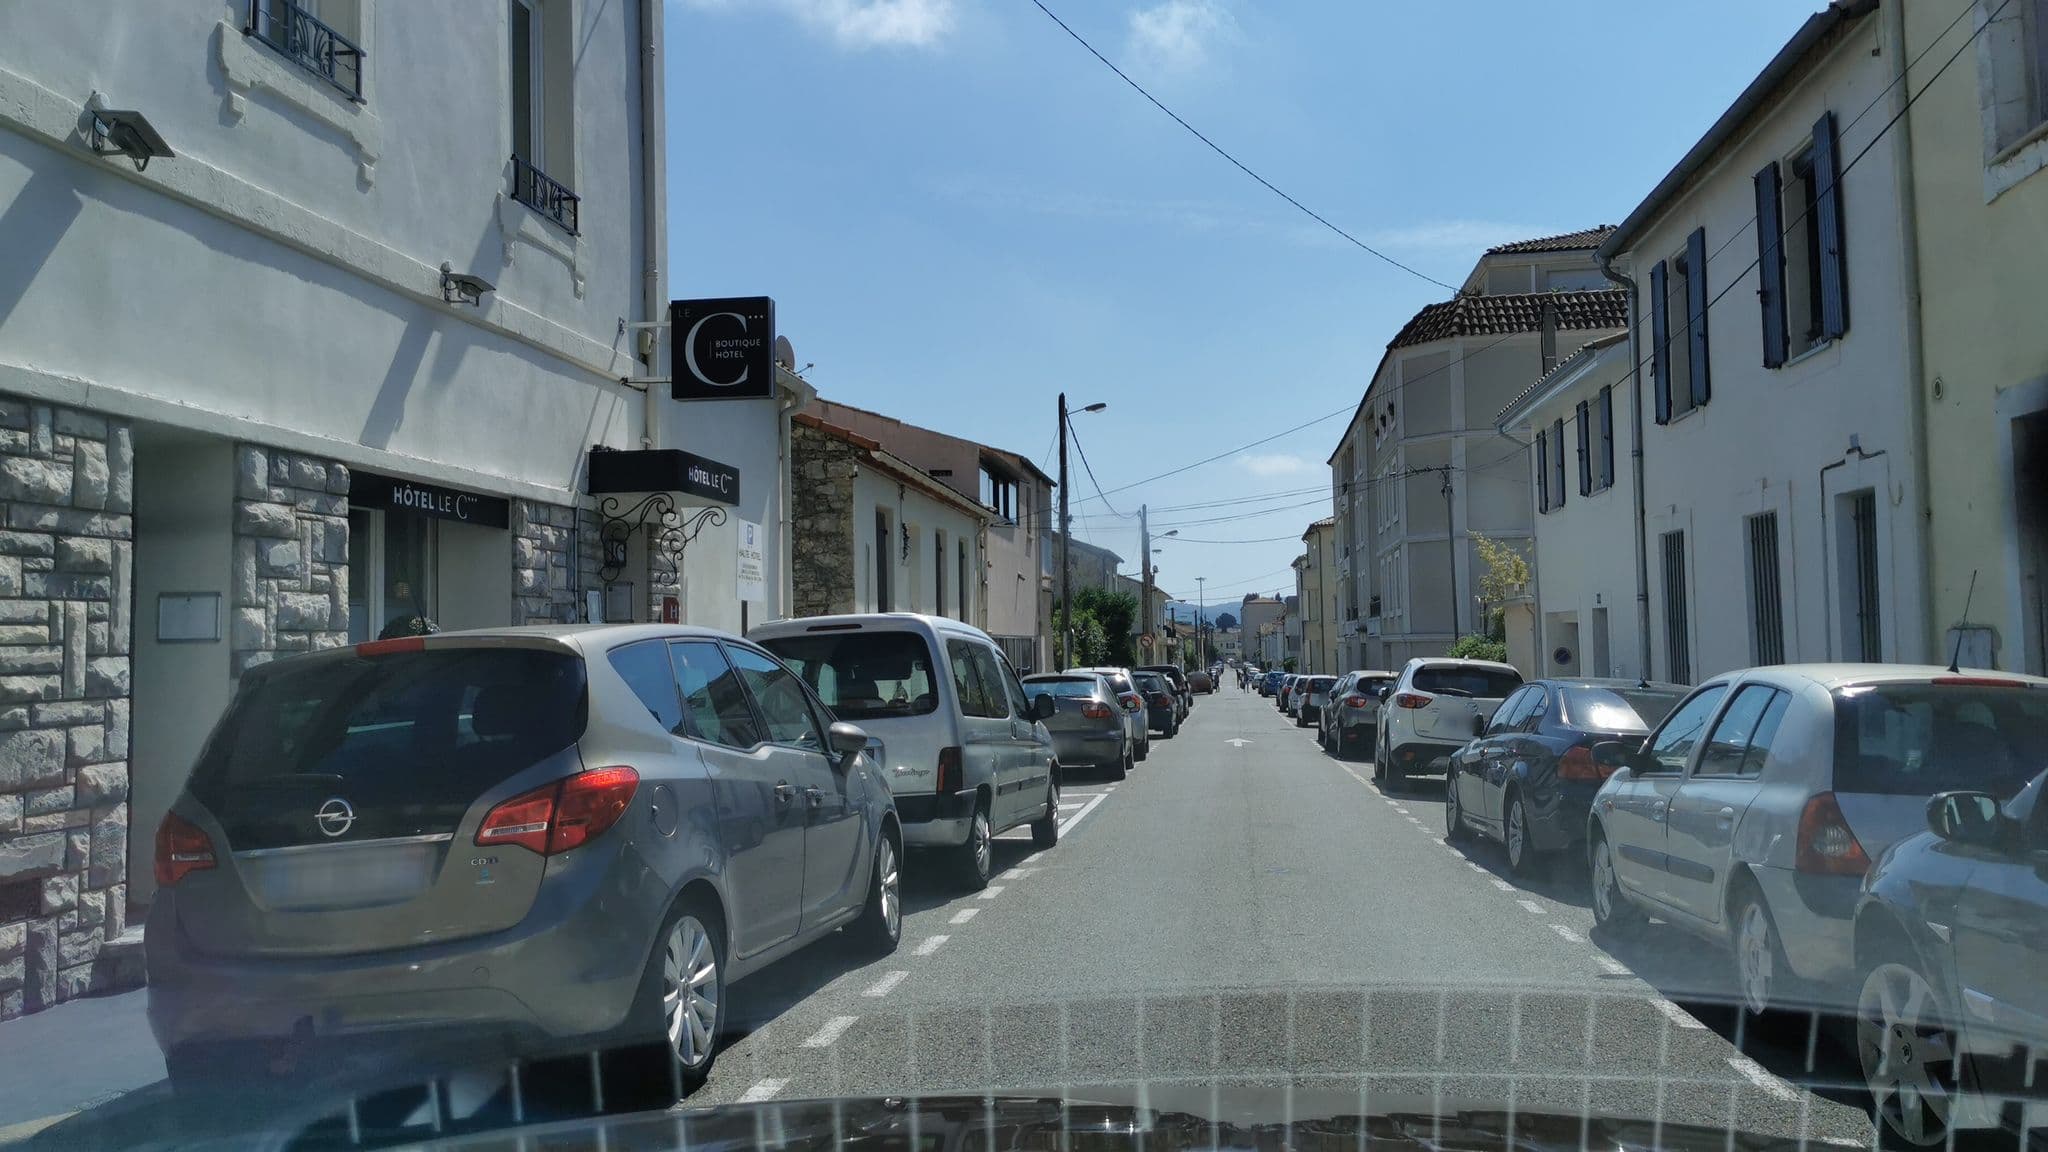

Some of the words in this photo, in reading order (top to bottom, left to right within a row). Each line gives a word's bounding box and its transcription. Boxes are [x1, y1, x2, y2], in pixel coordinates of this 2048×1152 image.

[715, 338, 761, 348] BOUTIQUE
[688, 465, 710, 486] HÔTEL
[711, 473, 719, 488] LE
[394, 484, 434, 509] HÔTEL
[438, 495, 451, 513] LE
